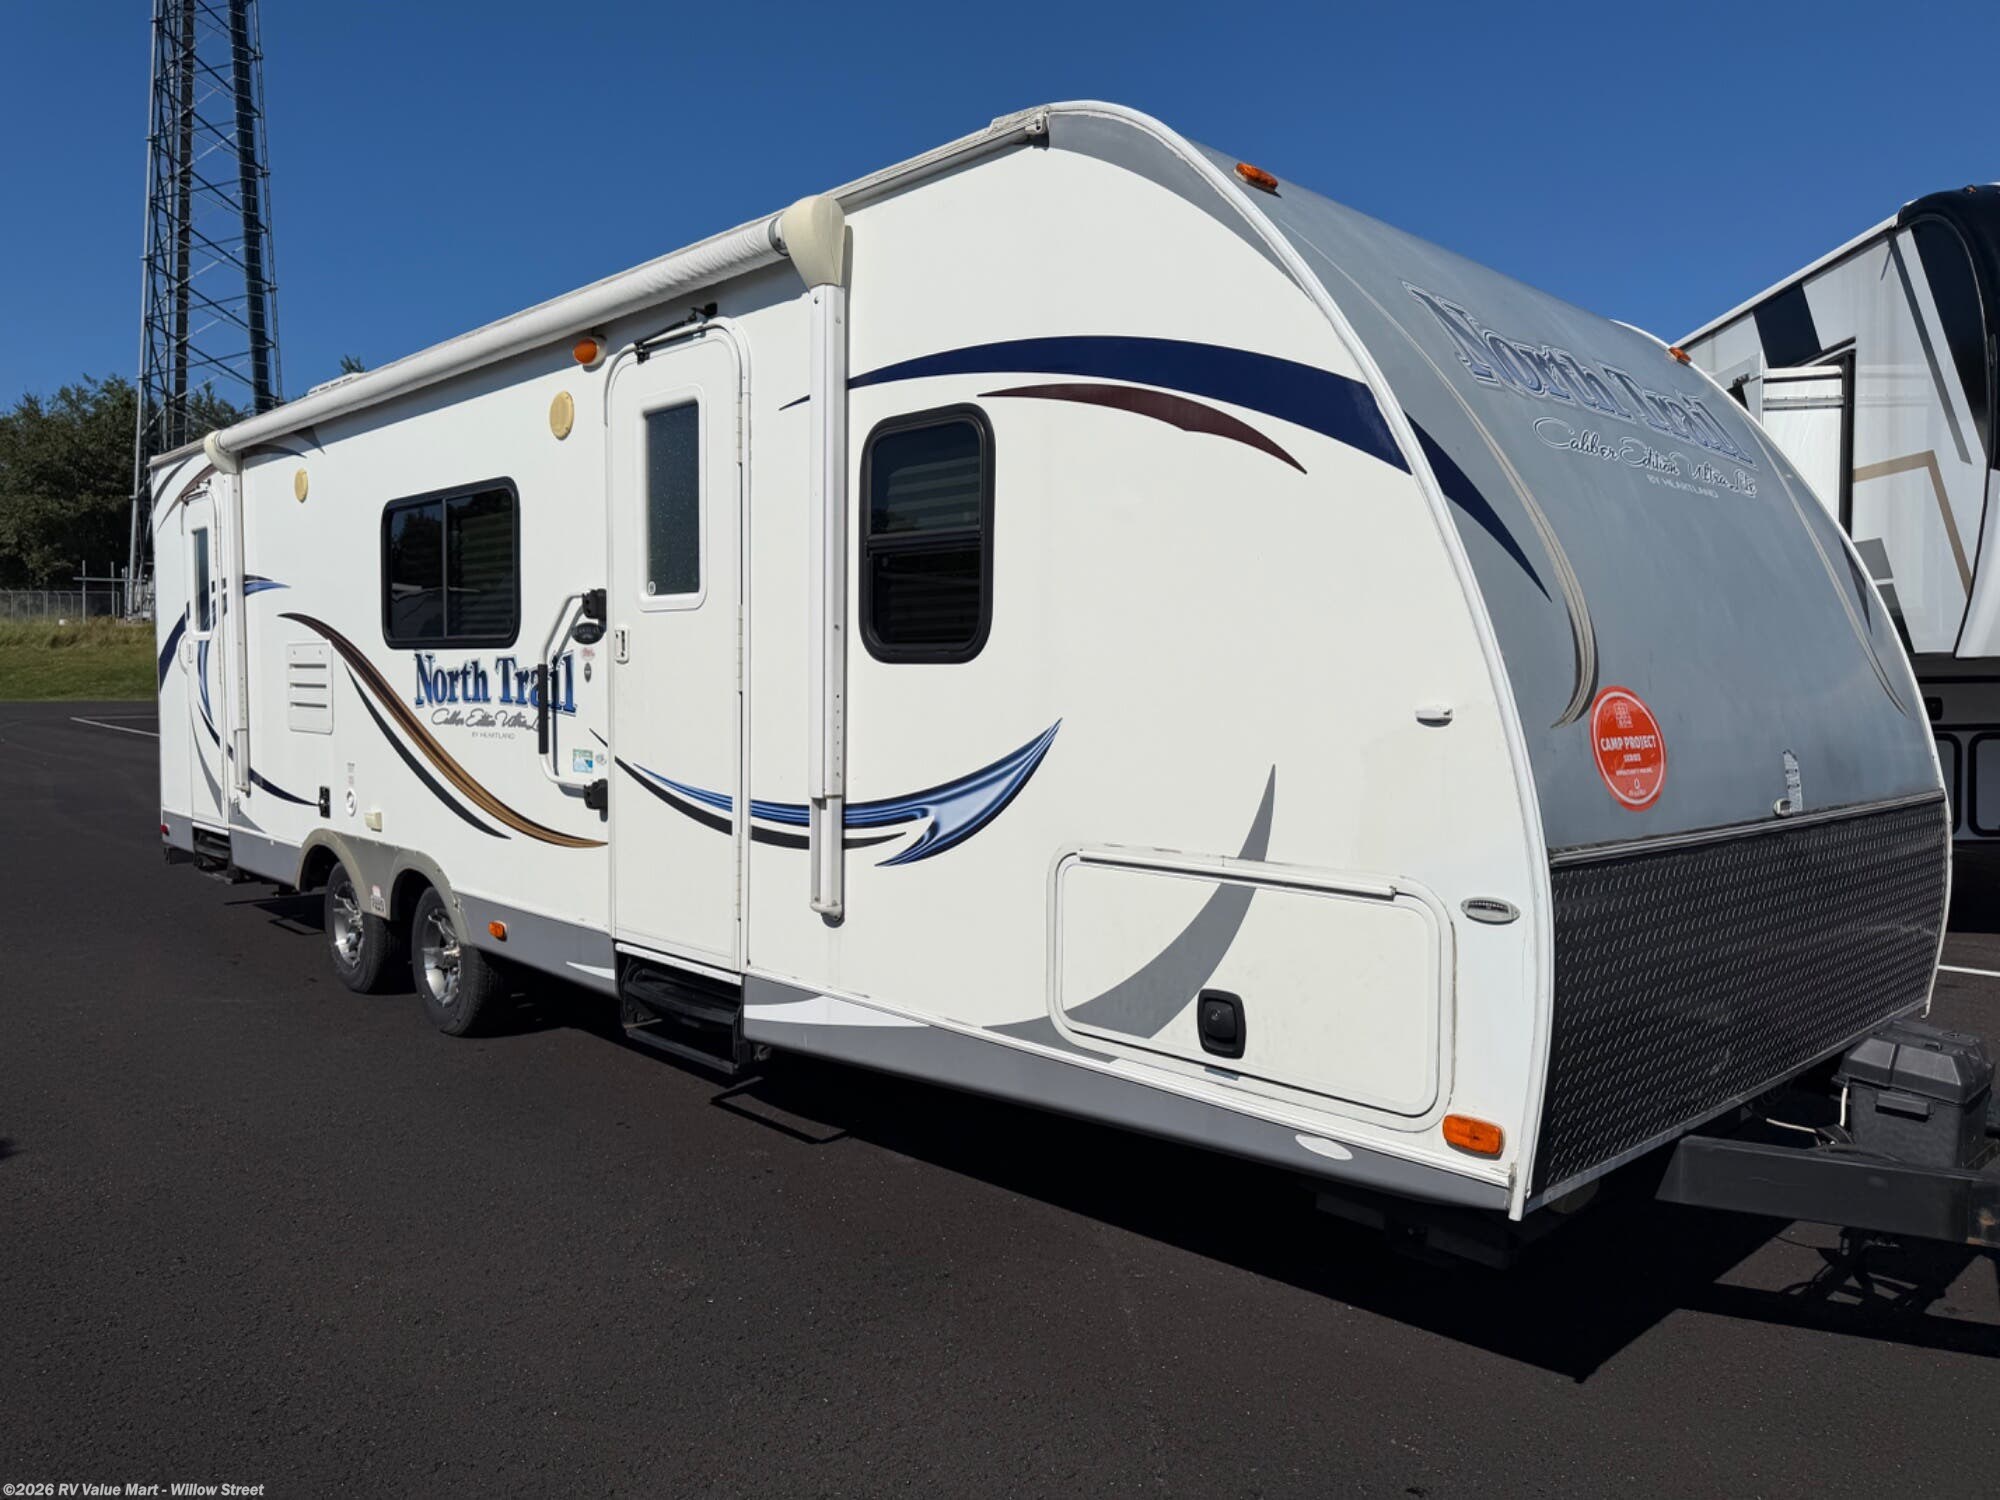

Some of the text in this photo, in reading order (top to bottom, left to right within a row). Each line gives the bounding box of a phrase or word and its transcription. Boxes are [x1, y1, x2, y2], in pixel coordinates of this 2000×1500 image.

[414, 650, 491, 708] North
[1600, 735, 1656, 751] CAMP PROJECT
